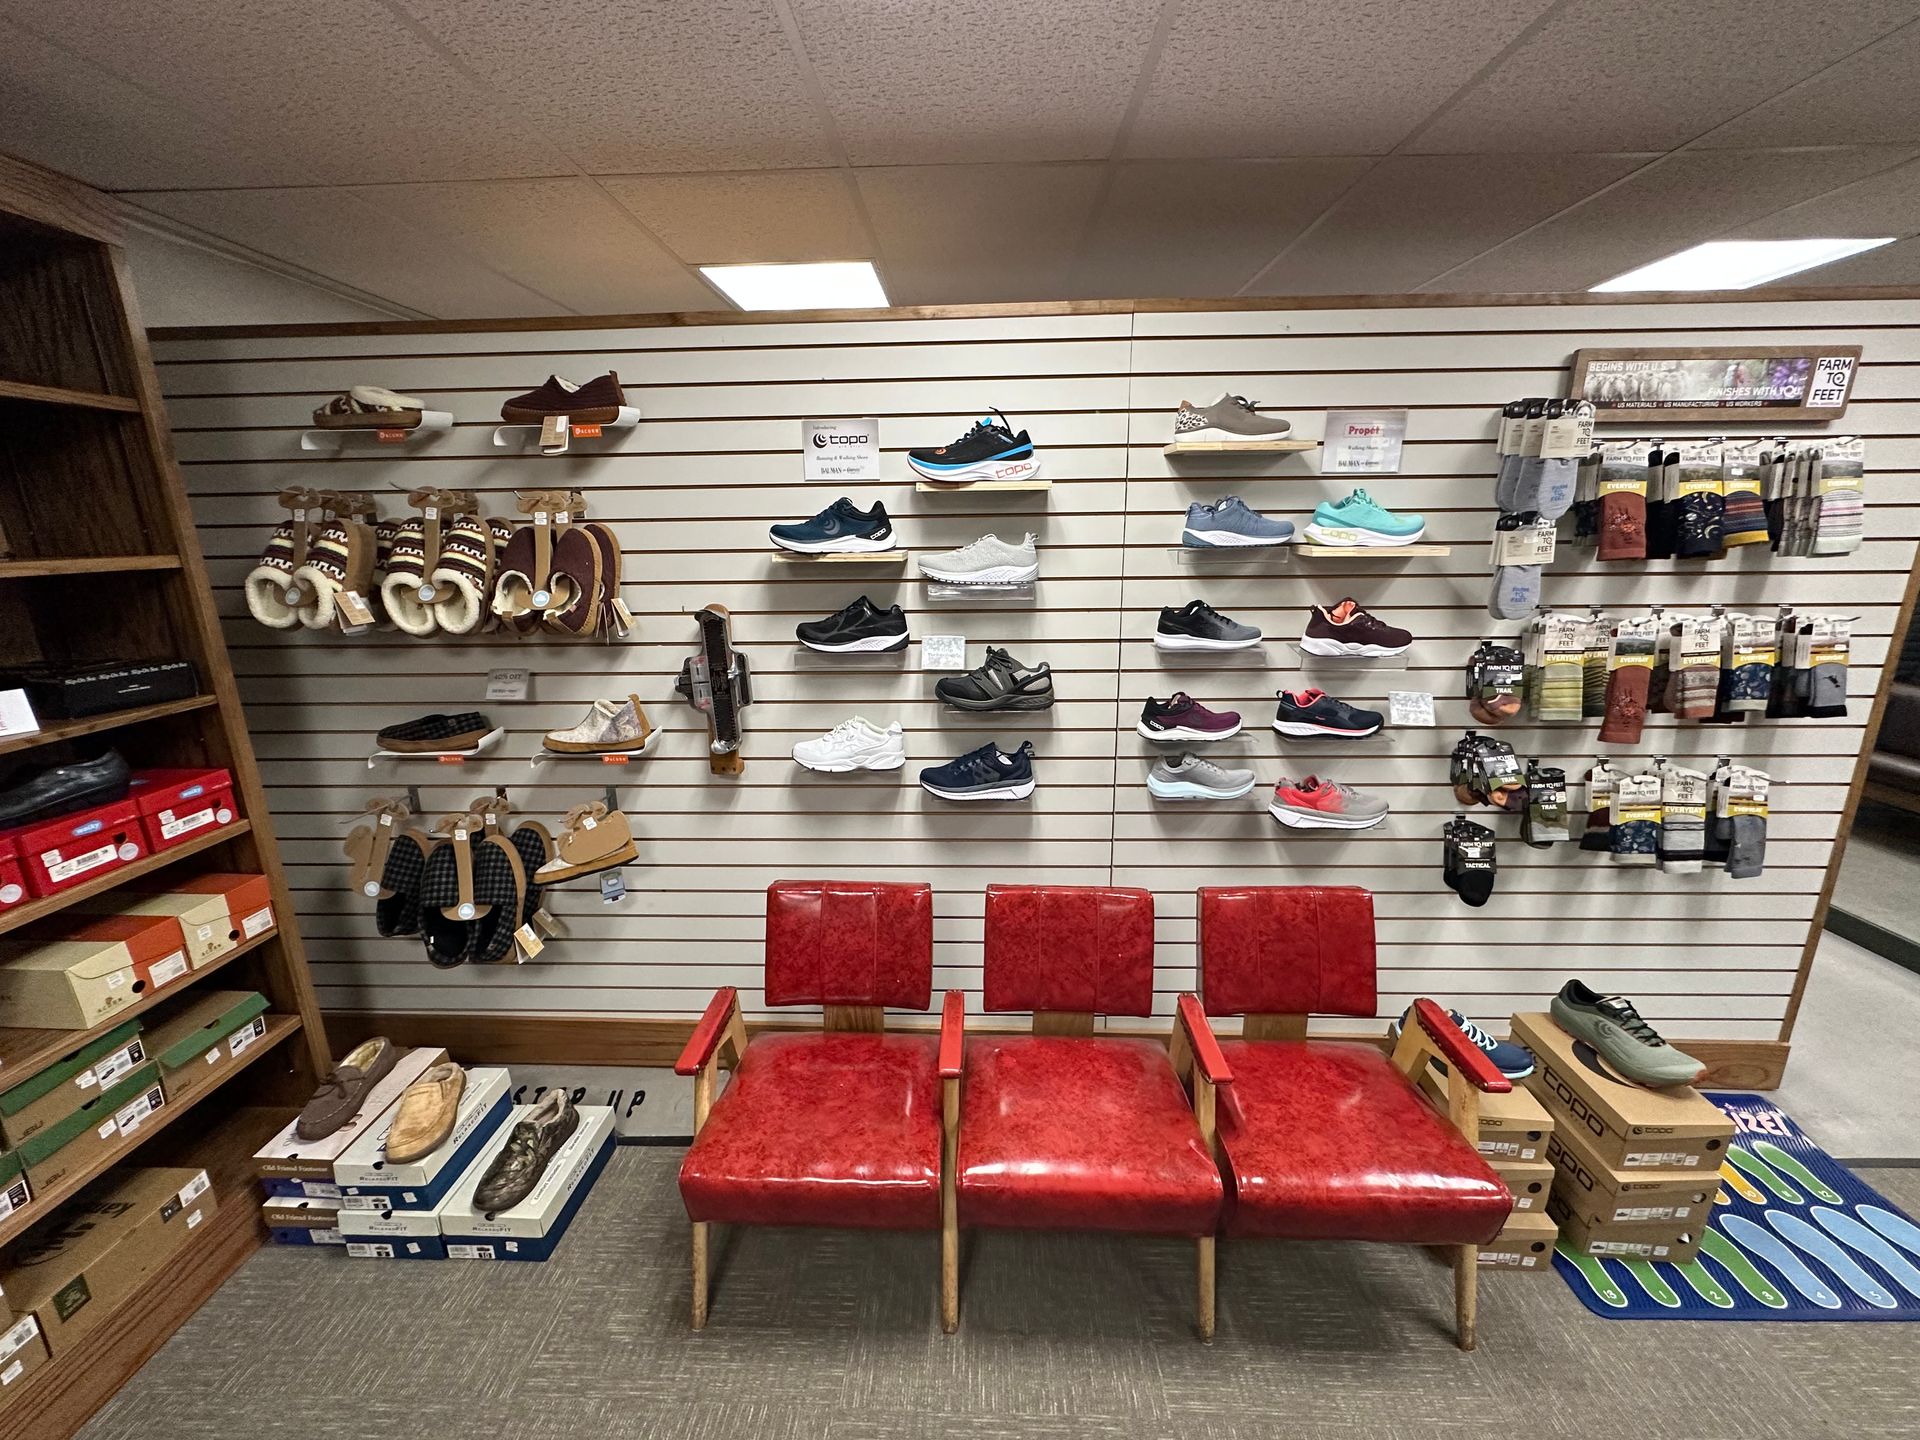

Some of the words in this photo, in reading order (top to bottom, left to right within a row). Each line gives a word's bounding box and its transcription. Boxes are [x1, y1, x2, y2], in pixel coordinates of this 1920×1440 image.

[1589, 362, 1623, 372] BEGINS
[1625, 362, 1649, 371] WITH
[1817, 359, 1852, 371] FARM
[1827, 372, 1846, 387] TO
[1708, 387, 1751, 397] FINISHES
[1752, 386, 1776, 396] WITH
[1812, 389, 1844, 401] FEET
[1582, 428, 1591, 436] TO
[829, 434, 868, 446] topo
[1543, 537, 1553, 545] TO
[1536, 545, 1552, 553] FEET
[1683, 656, 1718, 664] EVERYDAY
[1665, 806, 1702, 814] EVERYDAY
[511, 1084, 587, 1105] STP
[1543, 1066, 1604, 1138] topo
[1727, 1109, 1793, 1137] IZE!
[1548, 1135, 1594, 1193] opo
[1603, 1289, 1617, 1300] 13
[1709, 1291, 1722, 1300] 2
[1761, 1290, 1774, 1300] 3
[1816, 1291, 1827, 1300] 4
[1868, 1290, 1882, 1300] 5
